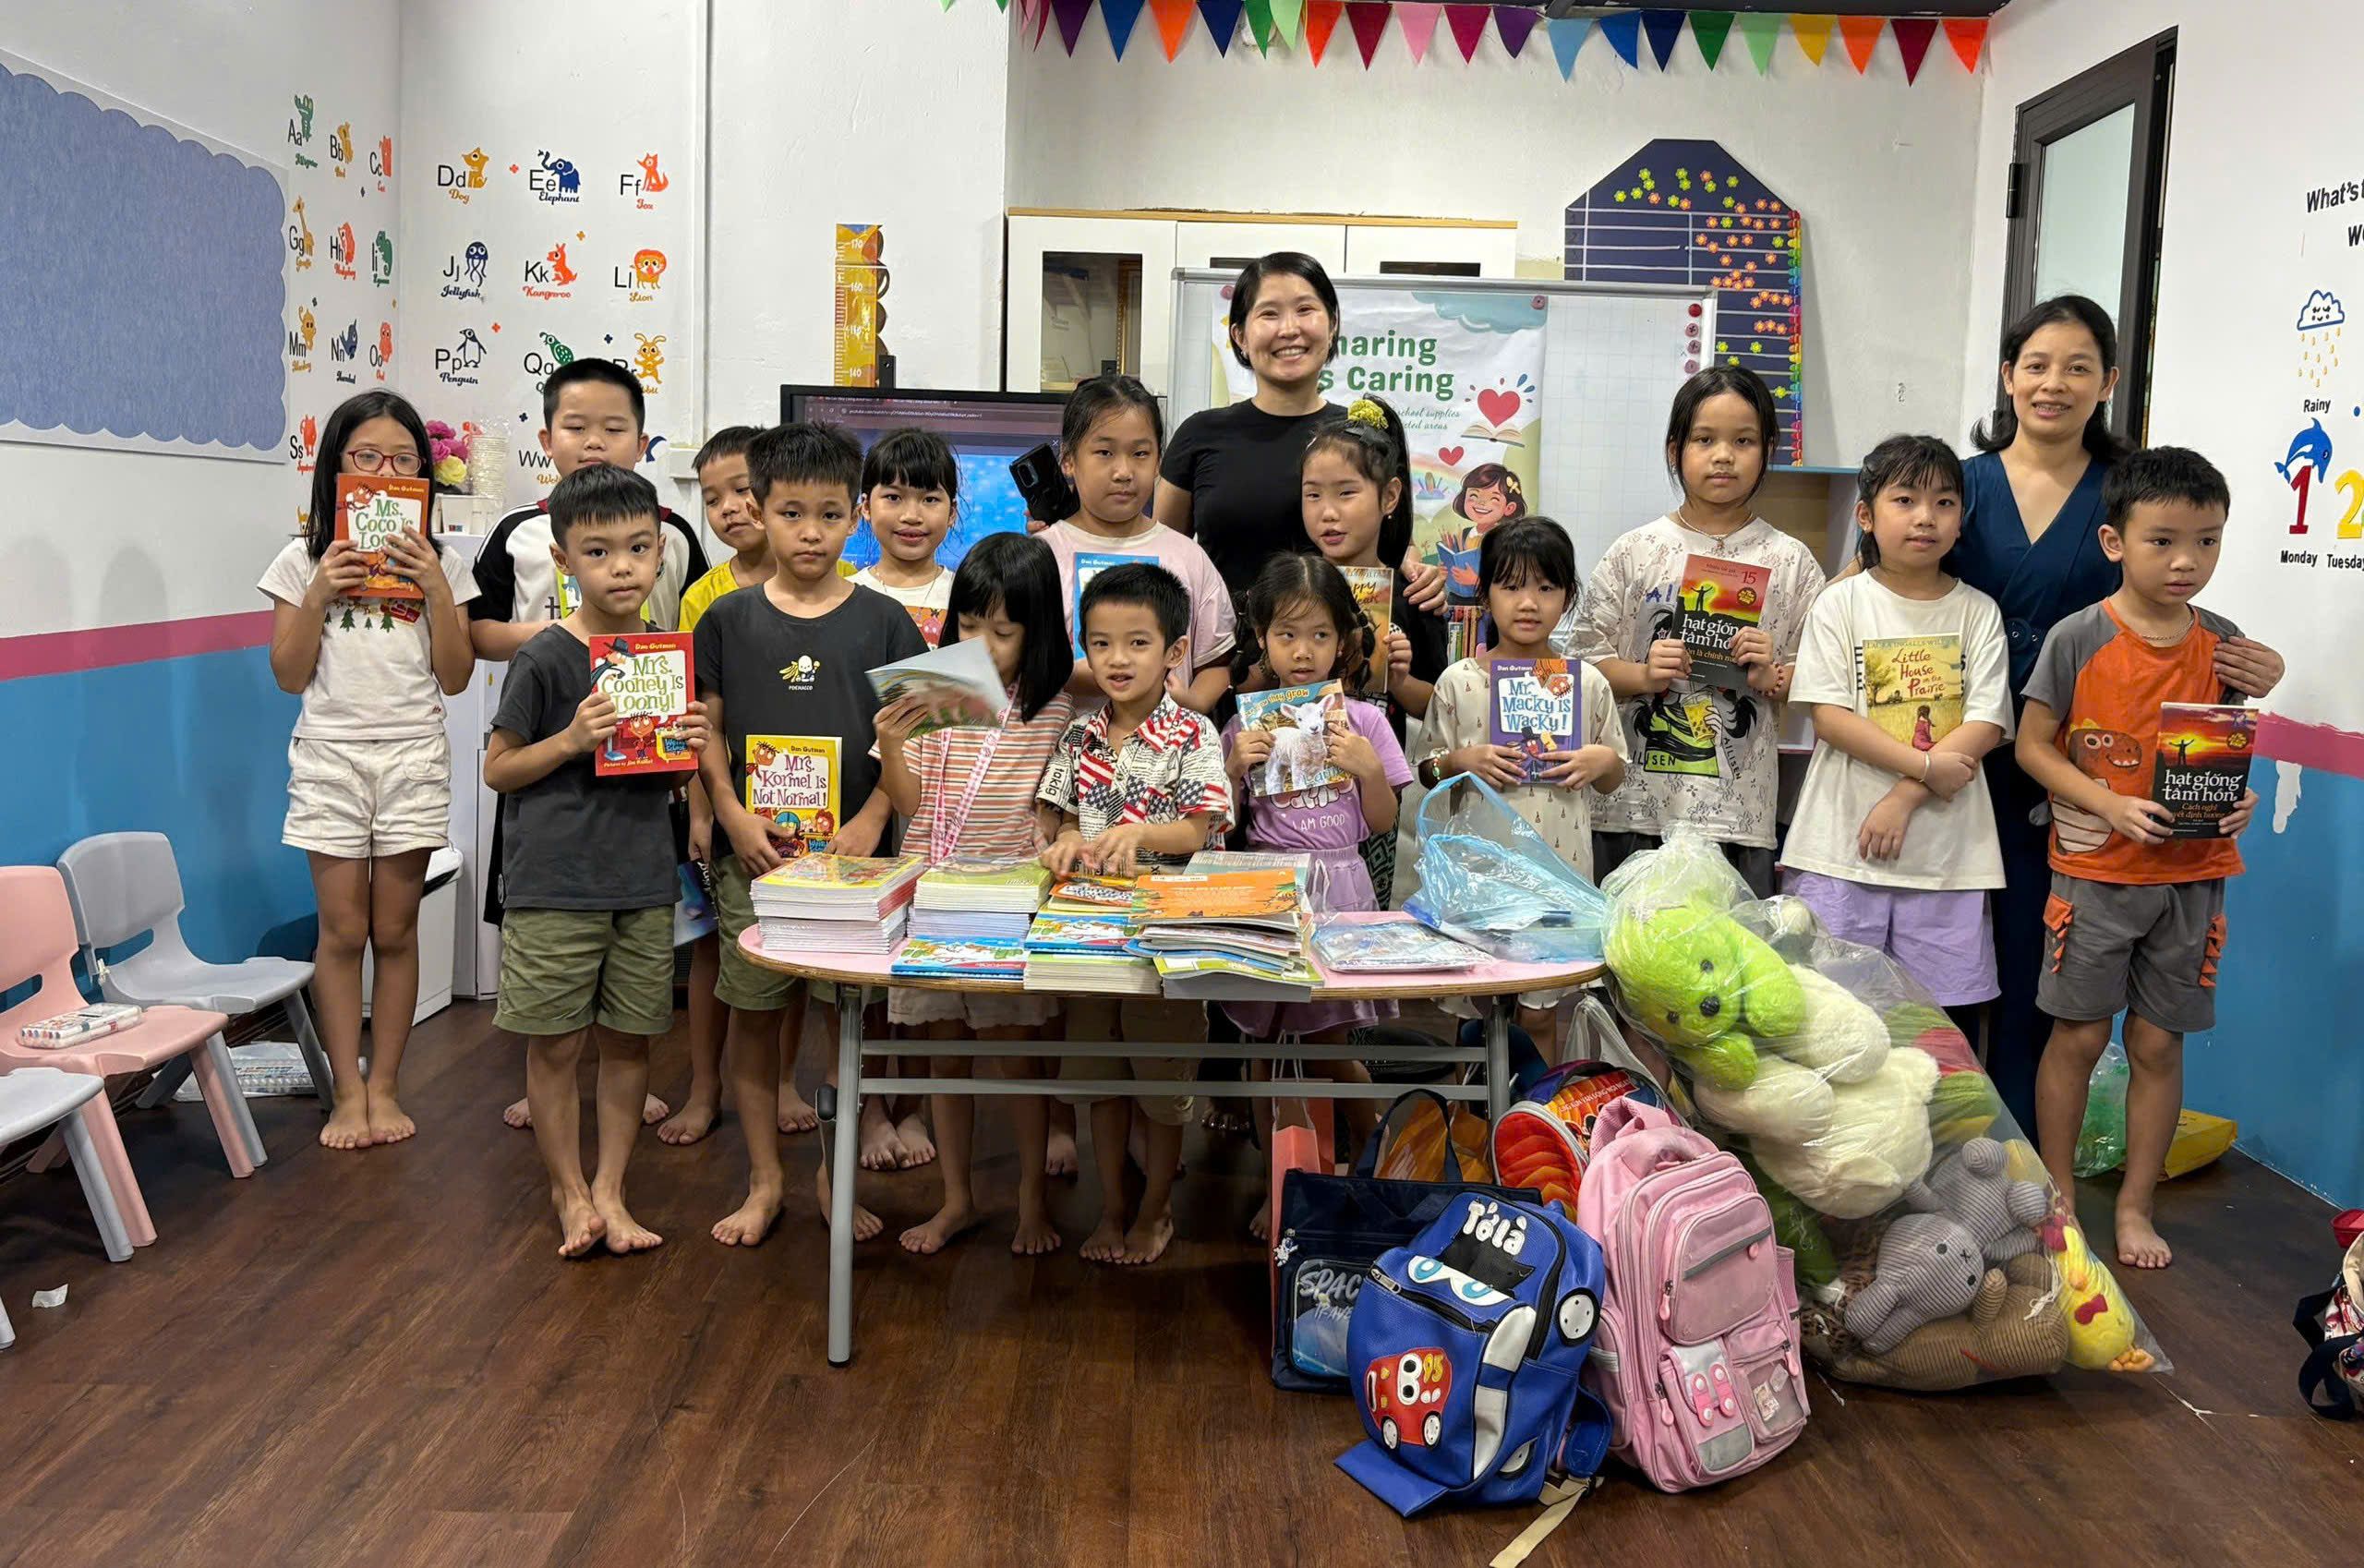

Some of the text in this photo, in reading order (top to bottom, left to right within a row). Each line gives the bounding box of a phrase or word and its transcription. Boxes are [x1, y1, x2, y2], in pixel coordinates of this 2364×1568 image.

[287, 118, 303, 147] Aa
[330, 135, 344, 162] Bb
[369, 151, 382, 177] Cc
[437, 164, 466, 188] Dd
[529, 169, 557, 192] Ee
[620, 174, 642, 197] Ff
[449, 188, 470, 205] Dog
[538, 191, 580, 206] Elephant
[636, 199, 654, 211] Fox
[2307, 181, 2359, 213] What's
[289, 225, 305, 258] Gg
[330, 235, 344, 263] Hh
[443, 256, 461, 283] Jj
[525, 260, 549, 283] Kk
[440, 285, 481, 300] Jellyfish
[629, 292, 654, 302] Lion
[289, 332, 307, 358] Mm
[332, 337, 345, 363] Nn
[369, 344, 383, 368] Oo
[1338, 329, 1438, 367] aring
[435, 348, 463, 375] Pp
[440, 371, 479, 387] Penguin
[1346, 364, 1454, 402] Caring
[1426, 407, 1460, 419] supplies
[2303, 398, 2332, 414] Rainy
[1423, 422, 1448, 430] areas
[289, 435, 304, 460] Ss
[518, 450, 551, 468] Ww
[374, 498, 404, 517] Ms.
[2288, 464, 2312, 535] 1
[2334, 469, 2364, 539] 2
[355, 512, 397, 533] Coco
[2280, 549, 2318, 568] Monday
[1742, 571, 1757, 585] 15
[1682, 613, 1740, 637] hạt giốn
[632, 655, 673, 677] Mrs.
[1891, 647, 1932, 664] Little
[1900, 664, 1935, 681] House
[601, 674, 684, 696] Cooney Is
[1285, 688, 1309, 702] grow
[1507, 679, 1536, 697] Mr.
[1907, 677, 1946, 697] Prairie
[1502, 694, 1556, 714] Macky
[784, 754, 815, 773] Mrs.
[760, 769, 827, 790] Kormel Is
[2164, 769, 2244, 791] hạt giống
[753, 789, 826, 807] Not Normal!
[2162, 784, 2198, 801] tâm
[1300, 817, 1316, 831] AM
[1319, 814, 1345, 828] GOOD
[1299, 1268, 1363, 1301] SPAC
[1422, 1353, 1444, 1383] 95
